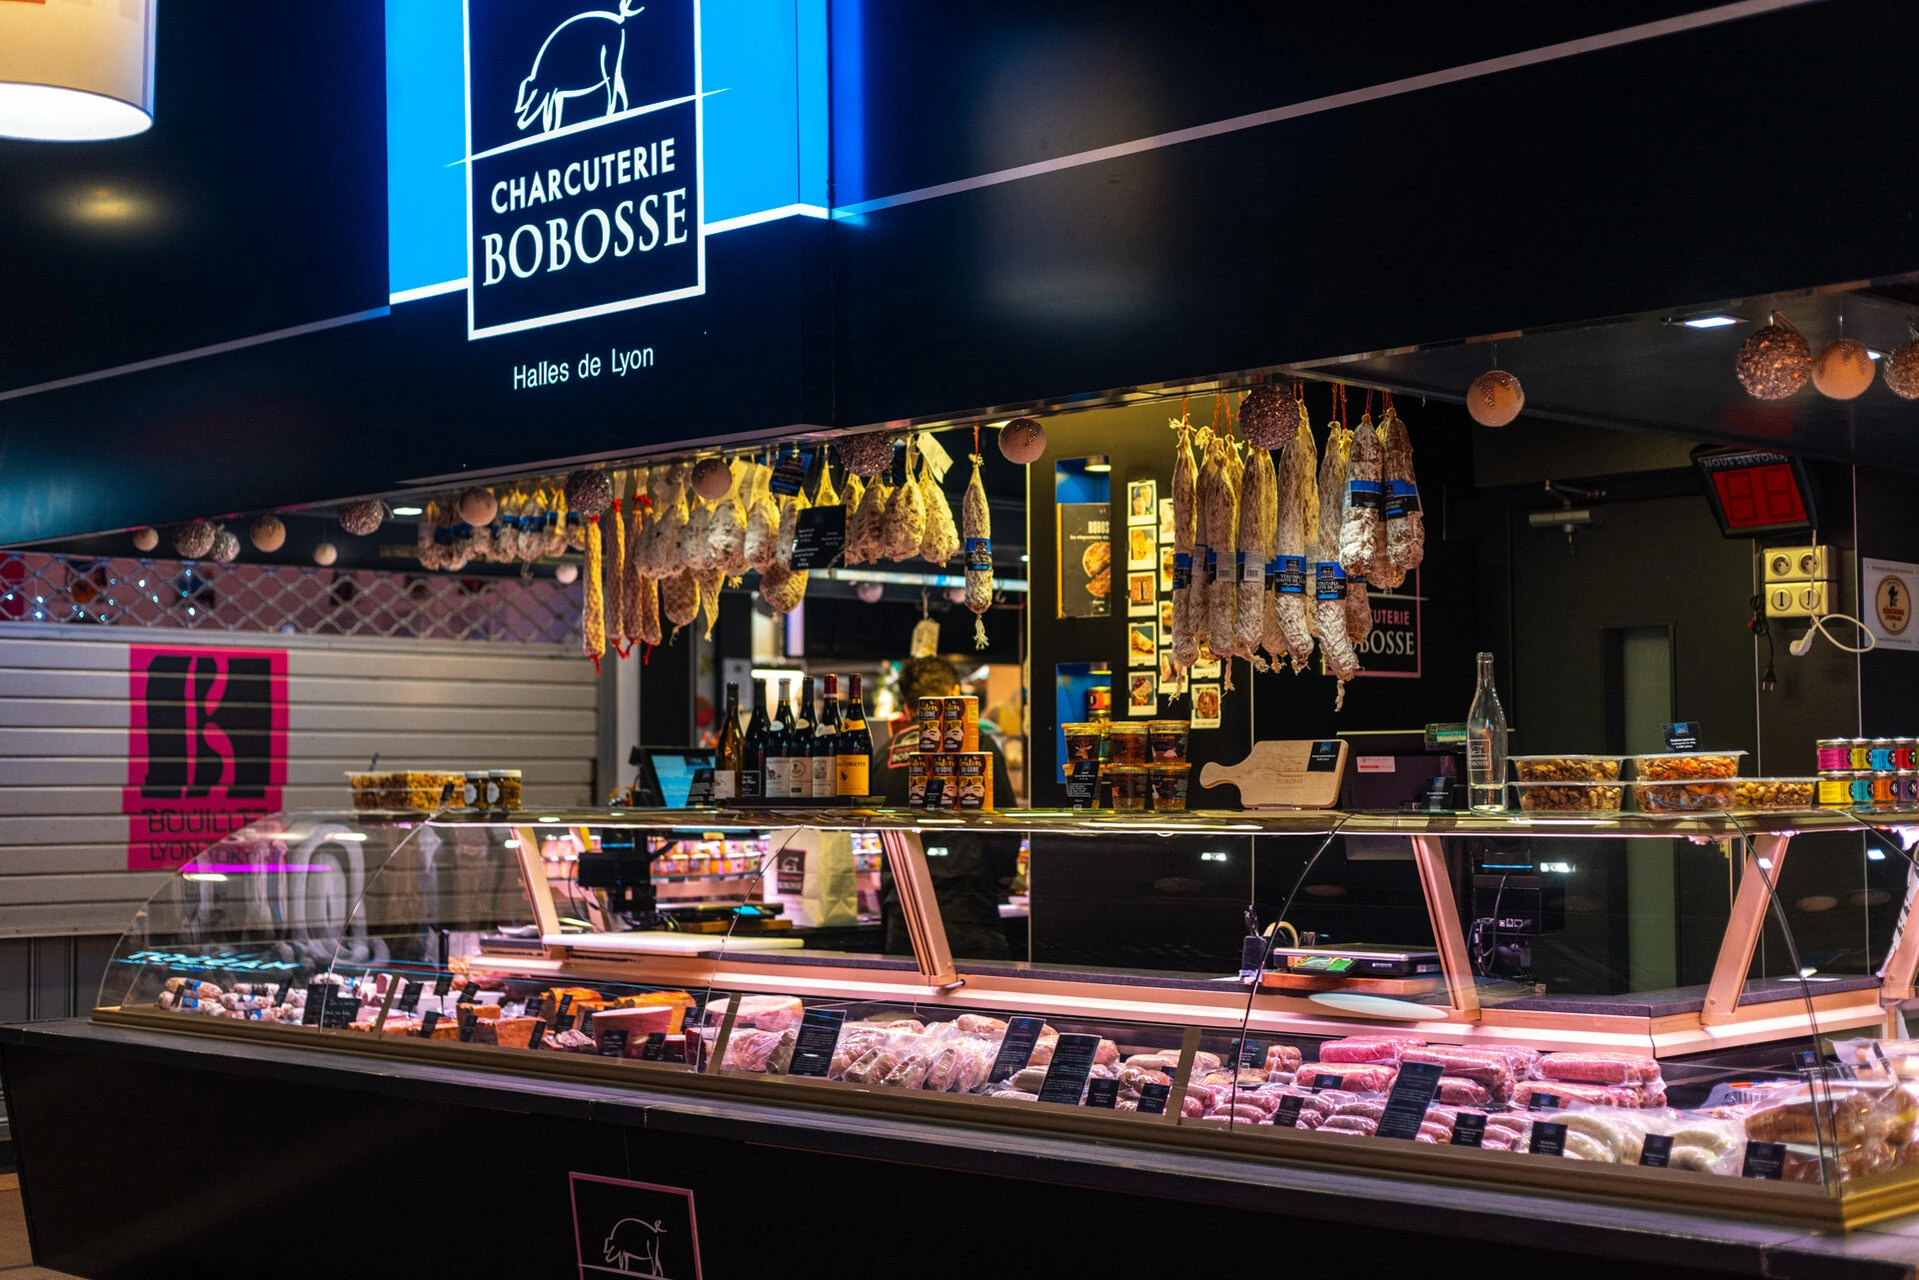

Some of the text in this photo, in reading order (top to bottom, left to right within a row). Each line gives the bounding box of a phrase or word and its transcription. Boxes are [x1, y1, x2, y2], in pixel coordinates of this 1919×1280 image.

[490, 137, 676, 214] CHARCUTERIE
[482, 187, 689, 287] BOBOSSE
[513, 346, 654, 390] Halles de Lyon
[1371, 608, 1410, 625] UTERIE
